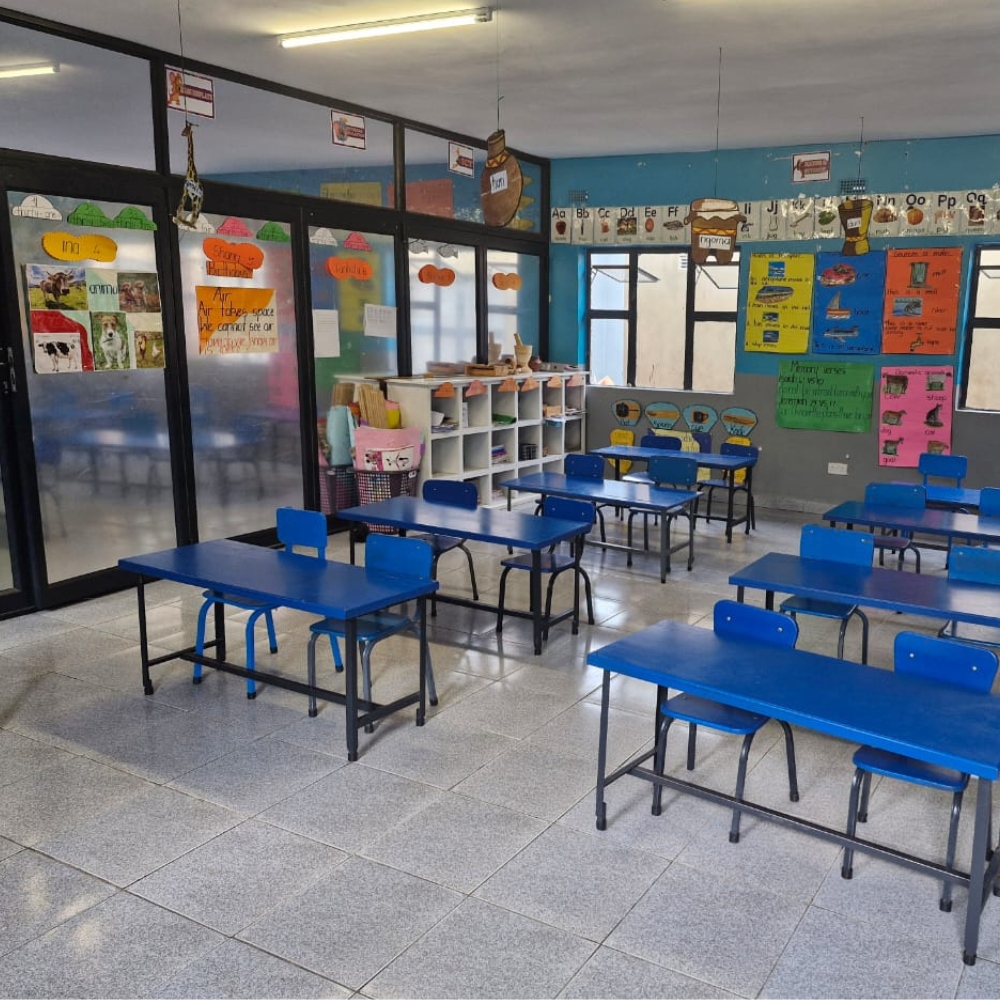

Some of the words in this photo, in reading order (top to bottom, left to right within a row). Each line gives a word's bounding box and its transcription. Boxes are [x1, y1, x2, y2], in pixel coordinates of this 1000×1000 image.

[906, 193, 926, 206] Oo
[937, 194, 957, 210] Pp
[551, 208, 566, 219] Aa
[576, 208, 589, 219] Bb
[597, 207, 610, 219] Cc
[620, 207, 635, 218] Dd
[644, 207, 657, 218] Ee
[667, 206, 679, 218] Ff
[766, 200, 779, 215] Jj
[212, 286, 233, 302] Air
[199, 300, 213, 317] Air
[249, 322, 262, 332] see
